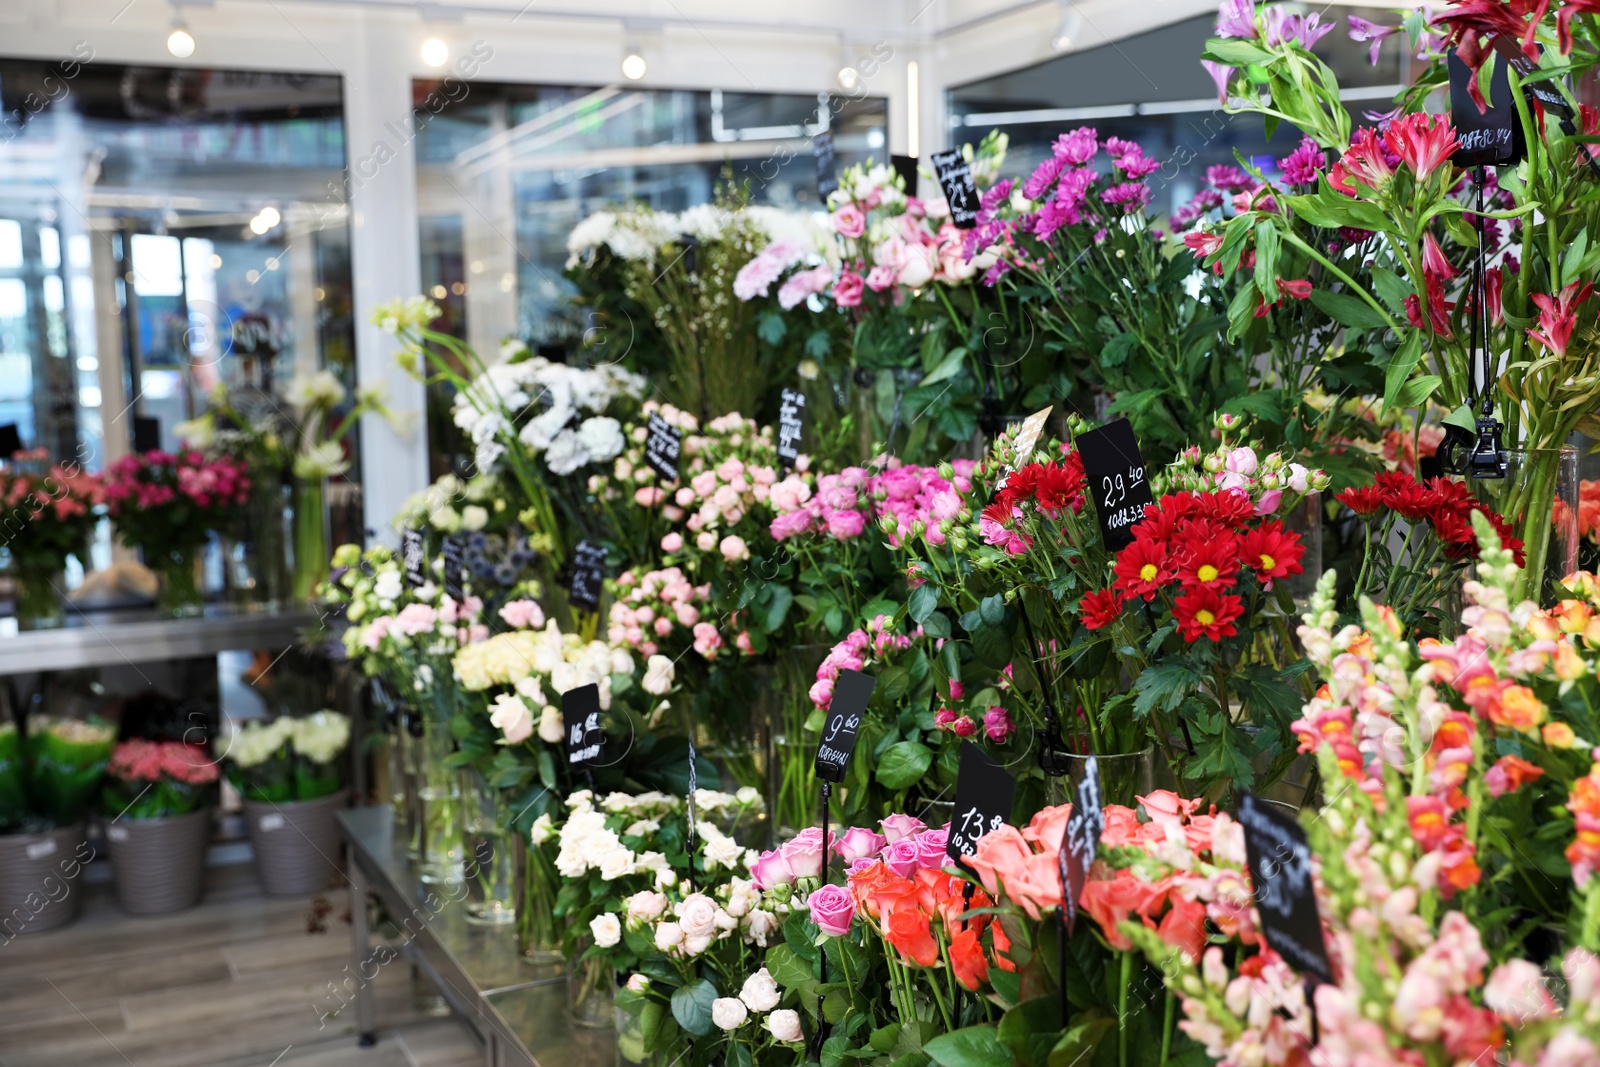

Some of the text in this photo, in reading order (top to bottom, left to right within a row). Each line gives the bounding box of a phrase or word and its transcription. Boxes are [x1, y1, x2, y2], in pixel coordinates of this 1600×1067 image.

[1102, 465, 1144, 507] 29 40
[569, 721, 583, 746] 16
[825, 713, 859, 742] 9 60
[961, 806, 984, 841] 13
